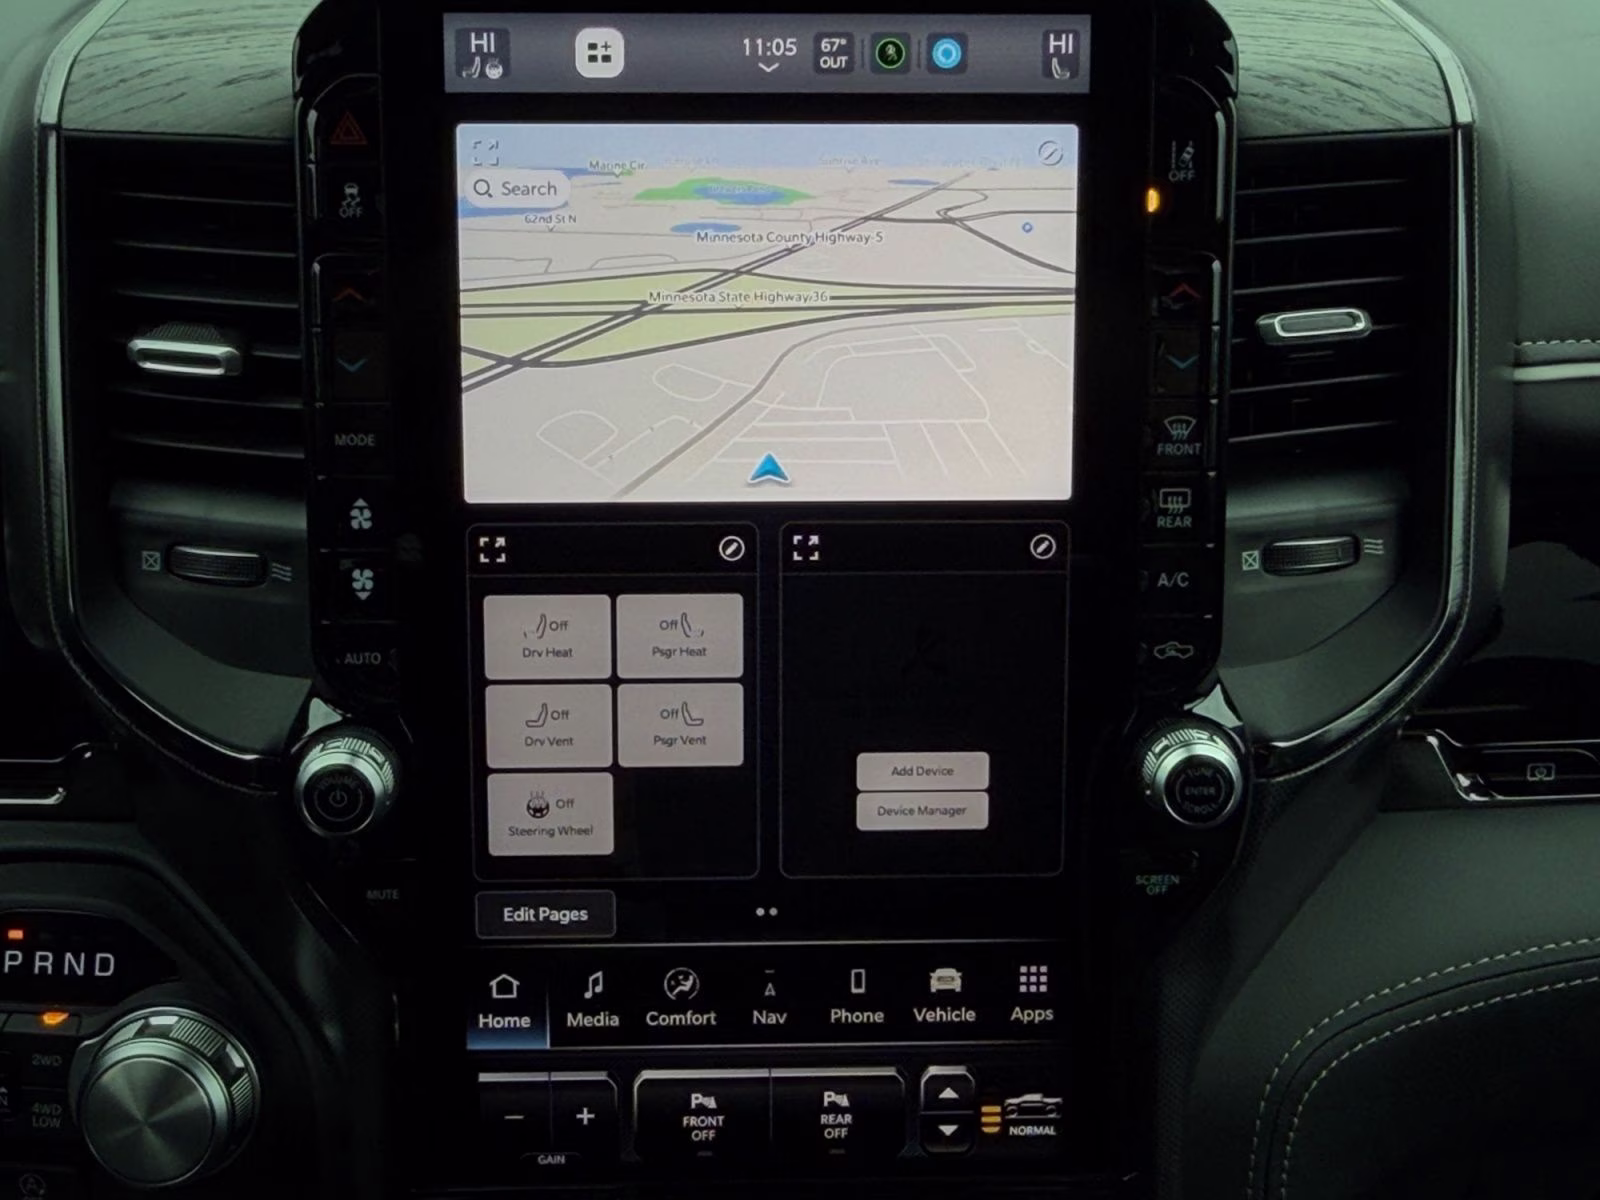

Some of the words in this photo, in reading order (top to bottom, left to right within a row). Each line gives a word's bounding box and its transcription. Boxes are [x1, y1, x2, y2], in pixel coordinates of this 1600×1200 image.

[471, 32, 495, 53] HI
[743, 37, 798, 56] 11:05
[1049, 33, 1073, 54] HI
[820, 55, 848, 69] OUT
[1168, 169, 1196, 182] OFF
[501, 181, 557, 196] Search
[338, 206, 363, 219] OFF
[525, 213, 552, 224] 62nd
[555, 213, 567, 224] St
[568, 213, 577, 223] N
[696, 231, 763, 243] Minnesota
[766, 231, 812, 245] County
[815, 231, 870, 245] Highway
[650, 291, 715, 303] Minnesota
[719, 291, 750, 303] State
[753, 291, 809, 305] Highway
[812, 291, 828, 302] 36
[334, 433, 376, 446] MODE
[1157, 442, 1201, 455] FRONT
[1157, 515, 1192, 528] REAR
[1157, 571, 1190, 587] A/C
[549, 619, 568, 631] Off
[659, 618, 678, 631] Off
[344, 652, 382, 665] AUTO
[522, 647, 543, 658] Drv
[546, 647, 573, 658] Heat
[652, 646, 677, 660] Psgr
[679, 646, 707, 657] Heat
[551, 709, 569, 721] Off
[660, 708, 679, 720] Off
[524, 736, 545, 747] Drv
[547, 736, 574, 747] Vent
[653, 735, 678, 749] Psgr
[679, 735, 707, 746] Vent
[891, 765, 914, 776] Add
[916, 765, 954, 776] Device
[555, 797, 574, 809] Off
[877, 805, 914, 817] Device
[917, 805, 967, 818] Manager
[508, 826, 555, 838] Steering
[557, 825, 593, 836] Wheel
[1135, 874, 1180, 886] SCREEN
[366, 888, 400, 900] MUTE
[1146, 885, 1168, 896] OFF
[503, 906, 535, 921] Edit
[539, 906, 588, 925] Pages
[478, 1013, 531, 1028] Home
[566, 1011, 620, 1027] Media
[646, 1010, 717, 1026] Comfort
[752, 1009, 787, 1025] Nav
[830, 1008, 884, 1023] Phone
[913, 1006, 976, 1022] Vehicle
[1010, 1006, 1054, 1023] Apps
[32, 1054, 63, 1067] 2WD
[31, 1102, 63, 1116] 4WD
[31, 1115, 62, 1128] LOW
[683, 1115, 725, 1127] FRONT
[820, 1113, 852, 1125] REAR
[691, 1129, 716, 1142] OFF
[824, 1127, 848, 1140] OFF
[1009, 1125, 1057, 1137] NORMAL
[537, 1154, 565, 1165] GAIN
